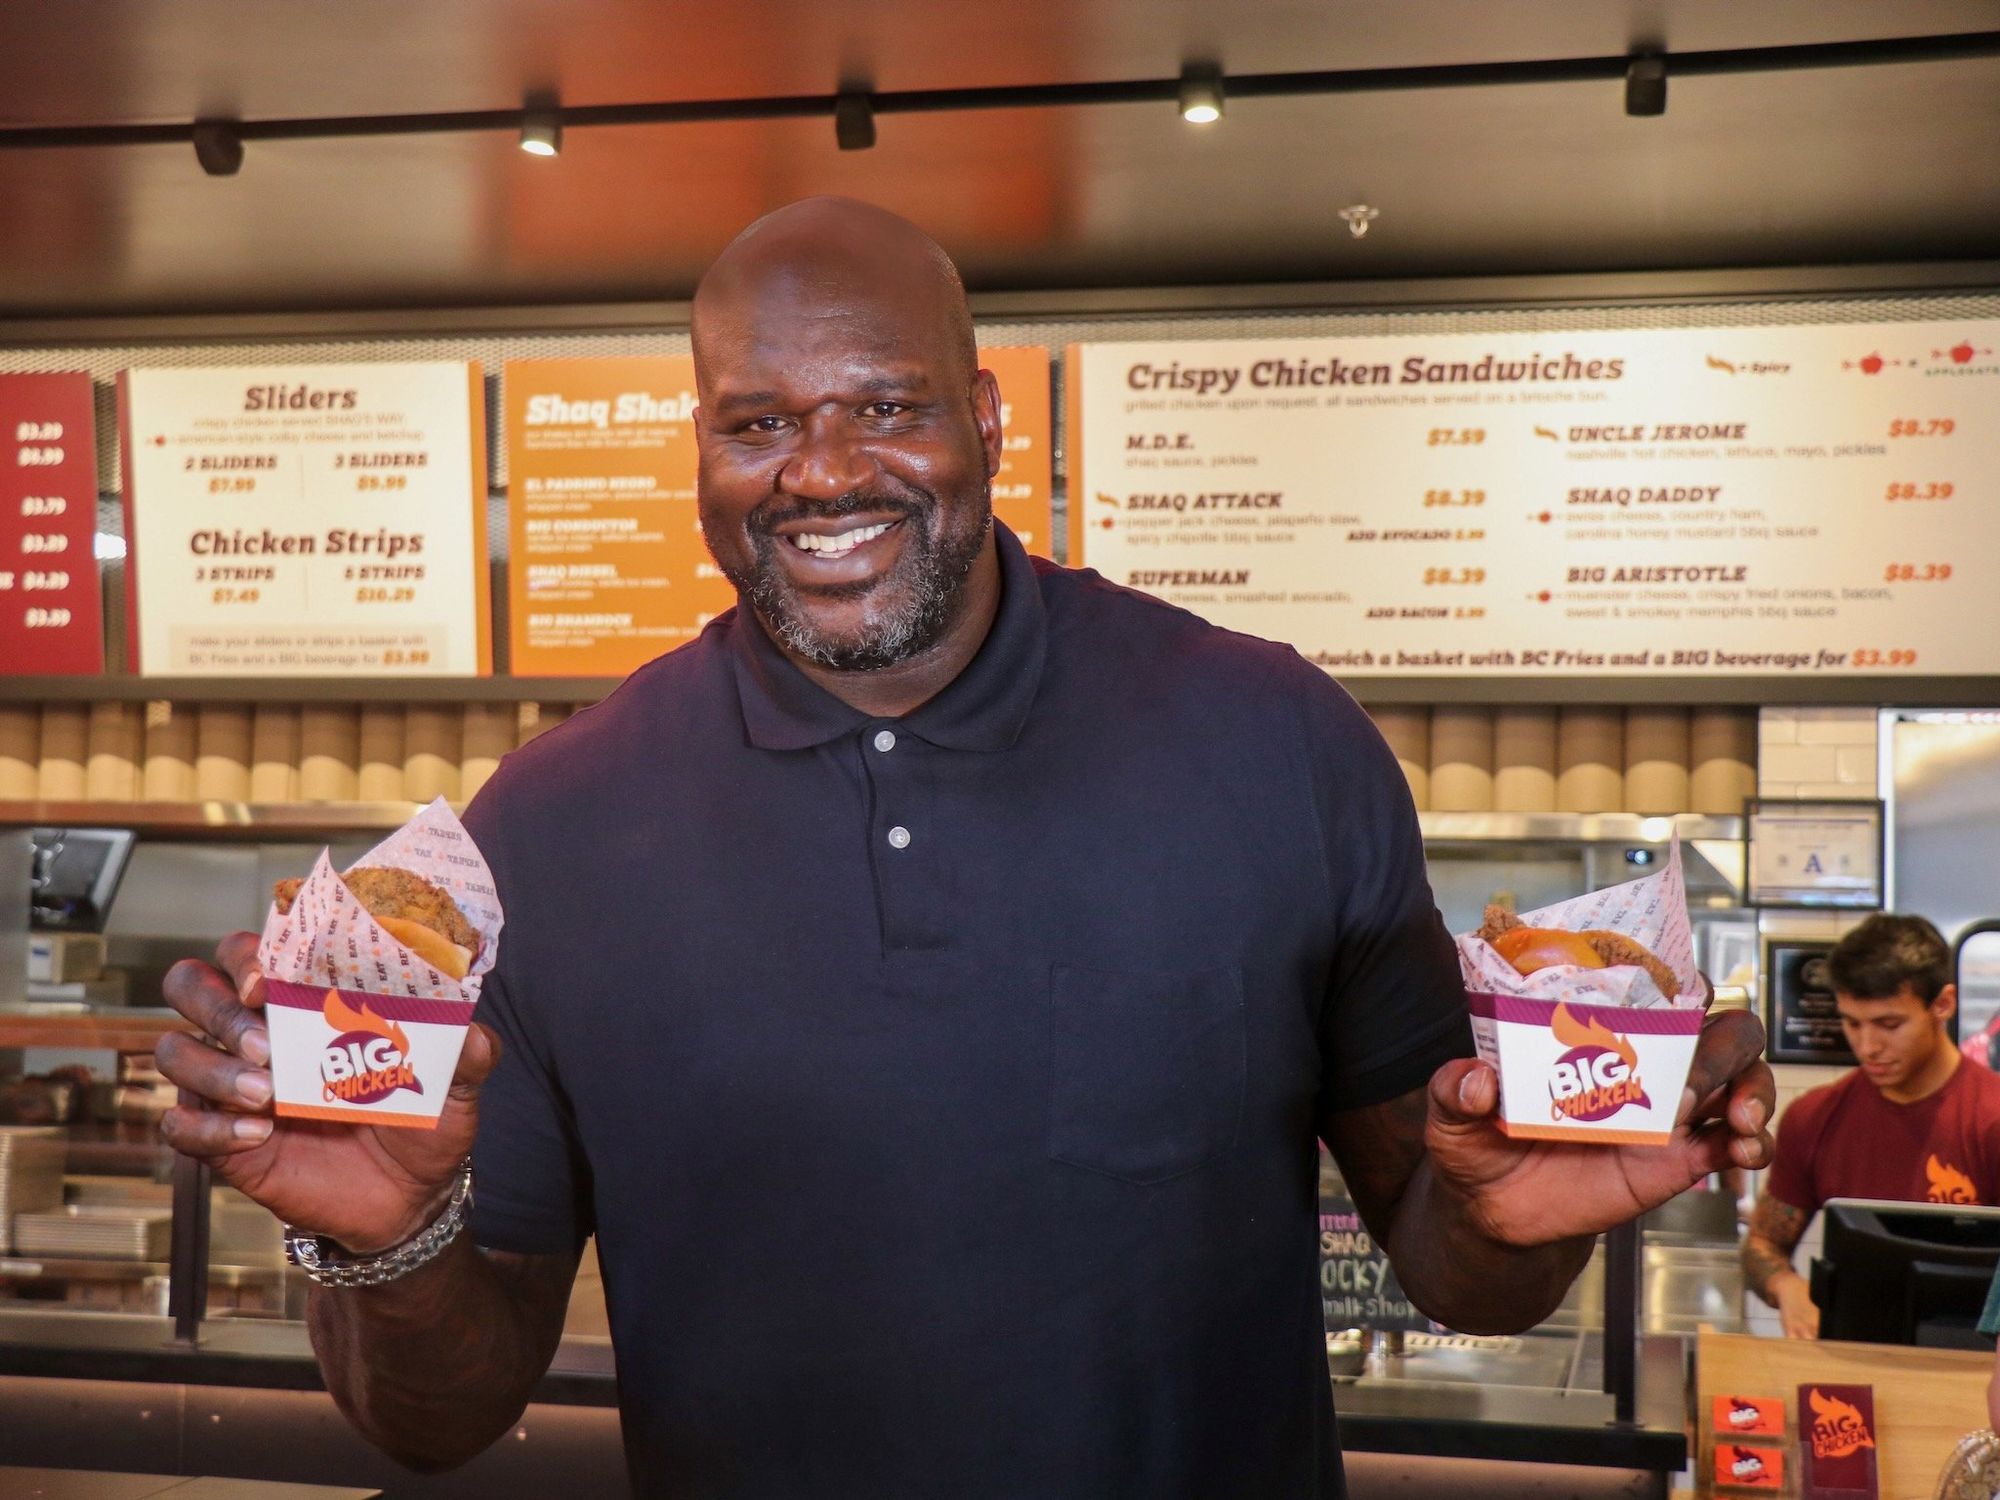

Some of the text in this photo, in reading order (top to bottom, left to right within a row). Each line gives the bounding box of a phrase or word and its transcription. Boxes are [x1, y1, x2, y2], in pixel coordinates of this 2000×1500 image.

[1127, 352, 1625, 395] Crispy Chicken Sandwiches
[244, 385, 358, 411] Sliders
[525, 391, 700, 429] Shaq Shak
[1569, 423, 1747, 442] UNCLE JEROME
[1888, 418, 1955, 437] $8.79
[1126, 434, 1195, 450] M.D.E.
[1833, 443, 1887, 456] pickles
[200, 455, 278, 470] SLIDERS
[350, 452, 429, 468] SLIDERS
[1127, 492, 1283, 512] SHAQ ATTACK
[1423, 488, 1487, 508] $8.39
[1567, 486, 1721, 506] SHAQ DADDY
[1885, 482, 1955, 502] $8.39
[190, 528, 425, 558] Chicken Strips
[210, 566, 276, 580] STRIPS
[359, 565, 427, 579] STRIPS
[1128, 570, 1250, 587] SUPERMAN
[1423, 566, 1487, 586] $8.39
[1567, 566, 1748, 583] BIG ARISTOTLE
[1884, 563, 1953, 582] $8.39
[1379, 653, 1391, 666] a
[1396, 650, 1465, 666] basket
[1469, 649, 1515, 666] with
[1520, 650, 1549, 665] BC
[1553, 650, 1604, 665] Fries
[1610, 650, 1650, 665] and
[1653, 654, 1666, 665] a
[1671, 649, 1709, 665] BIG
[1714, 649, 1811, 669] beverage
[1813, 648, 1847, 669] for
[1852, 649, 1918, 667] $3.99
[1804, 852, 1823, 874] A
[326, 953, 339, 986] EPEAT
[376, 961, 388, 981] EAT
[354, 976, 365, 991] AT
[407, 984, 418, 997] AT
[321, 1038, 402, 1081] BIG
[323, 1062, 414, 1103] CHICKEN
[1551, 1052, 1630, 1099] BIG
[1551, 1077, 1643, 1122] CHICKEN
[1321, 1258, 1389, 1296] OCKY
[1814, 1416, 1857, 1441] BIG
[1814, 1426, 1869, 1458] CHICKEN
